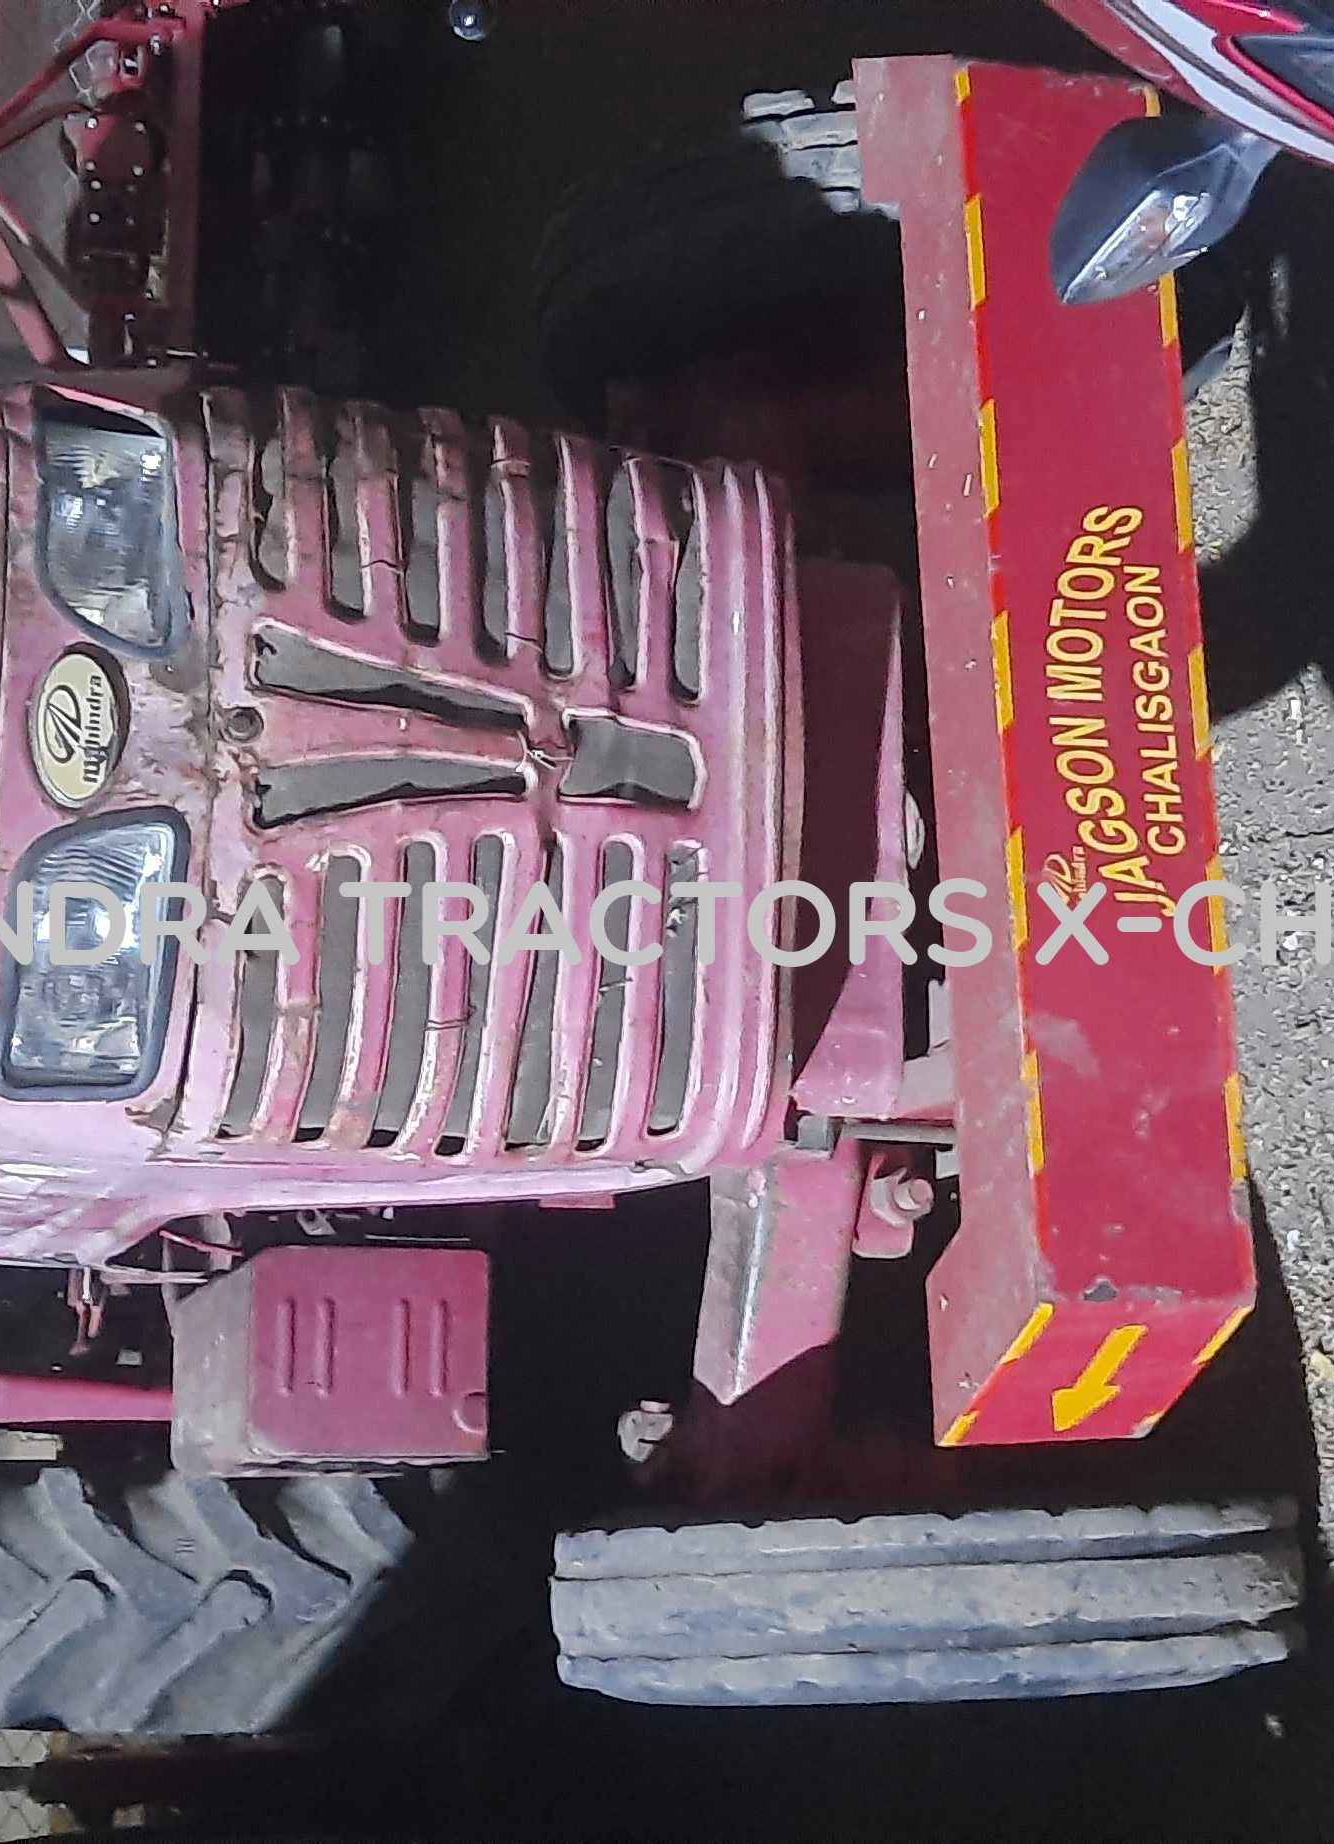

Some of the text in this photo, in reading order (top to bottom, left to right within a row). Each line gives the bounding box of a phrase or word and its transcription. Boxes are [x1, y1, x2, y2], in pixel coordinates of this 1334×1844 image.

[1045, 504, 1177, 917] JAGSON MOTORS
[1123, 564, 1187, 855] CHALISGAON
